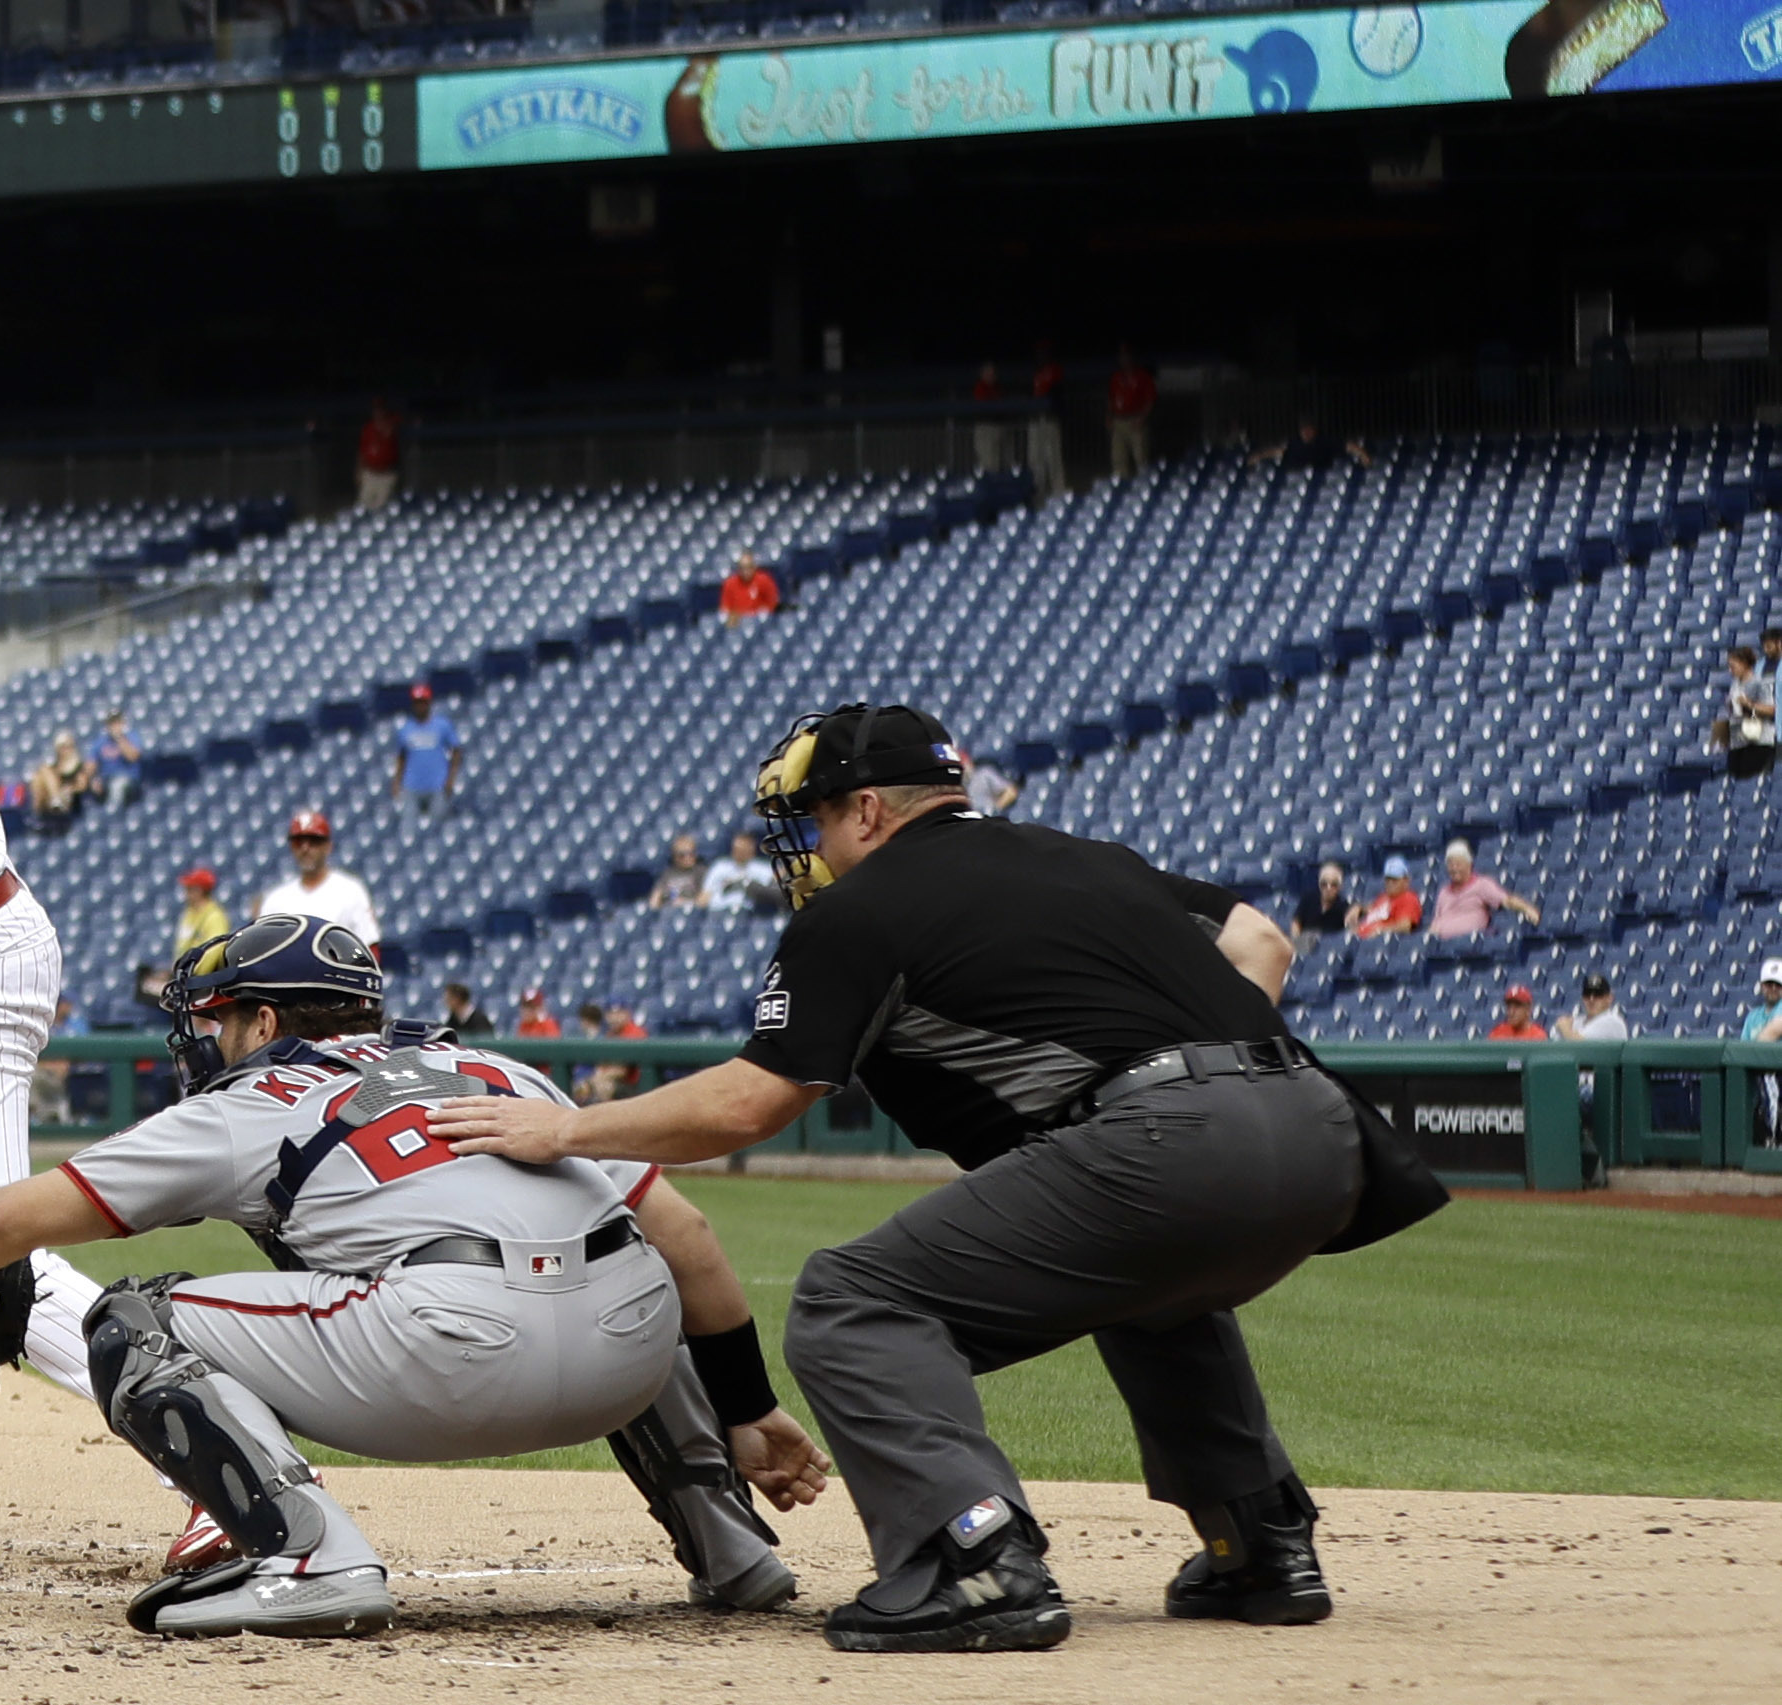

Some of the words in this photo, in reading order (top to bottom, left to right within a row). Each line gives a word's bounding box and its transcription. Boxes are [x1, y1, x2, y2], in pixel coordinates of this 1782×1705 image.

[278, 110, 300, 144] 0
[362, 104, 384, 138] 0
[463, 88, 638, 144] TASTYKAKE
[279, 144, 300, 177] 0
[321, 141, 341, 175] 0
[363, 138, 384, 173] 0
[1414, 1106, 1524, 1135] POWERADE
